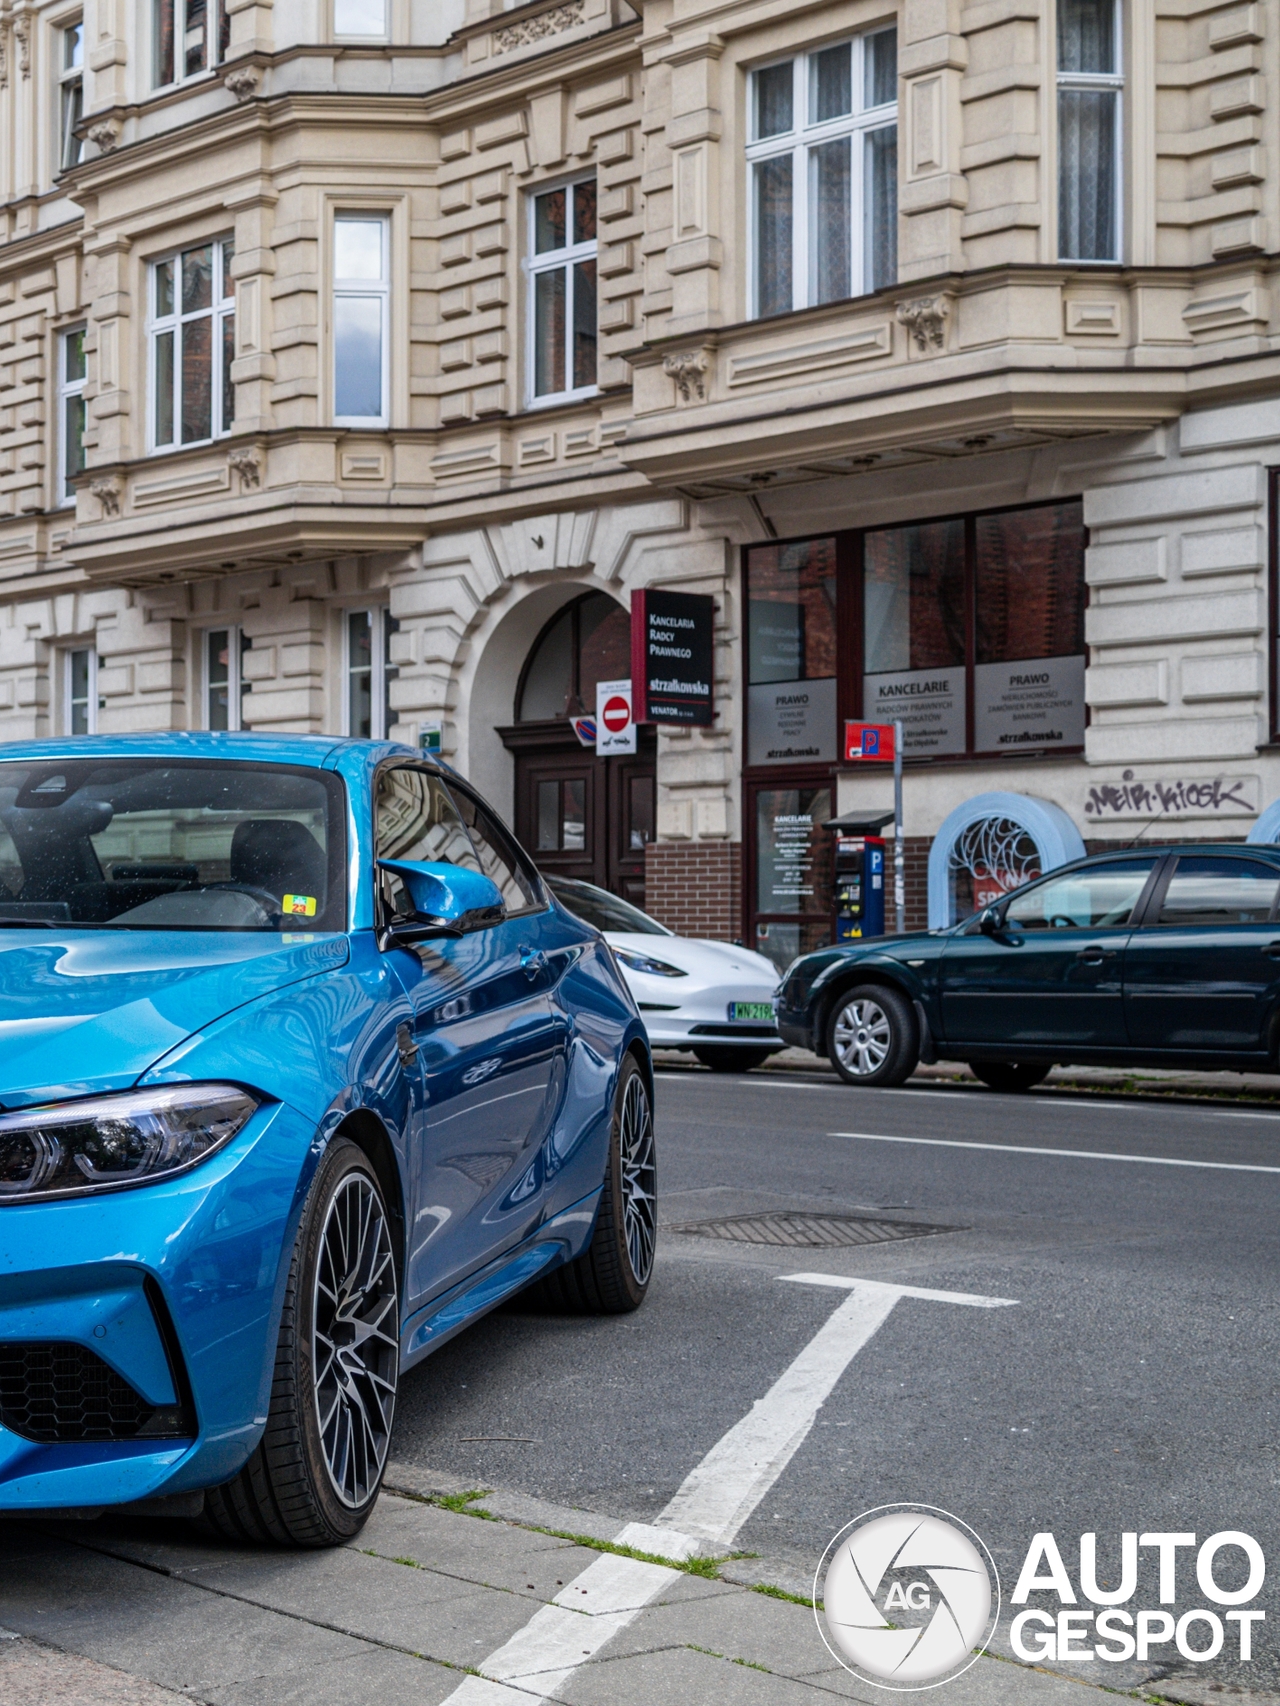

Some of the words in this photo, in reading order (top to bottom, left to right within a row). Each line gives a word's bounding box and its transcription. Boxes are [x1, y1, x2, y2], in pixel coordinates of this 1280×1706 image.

[649, 613, 695, 629] KANCELARIA
[649, 629, 675, 642] RADCY
[649, 643, 692, 659] PRAWNEGO
[1009, 673, 1050, 686] PRAWO
[879, 681, 950, 698] KANCELARIE
[776, 694, 809, 705] PRAWO
[872, 852, 882, 869] P
